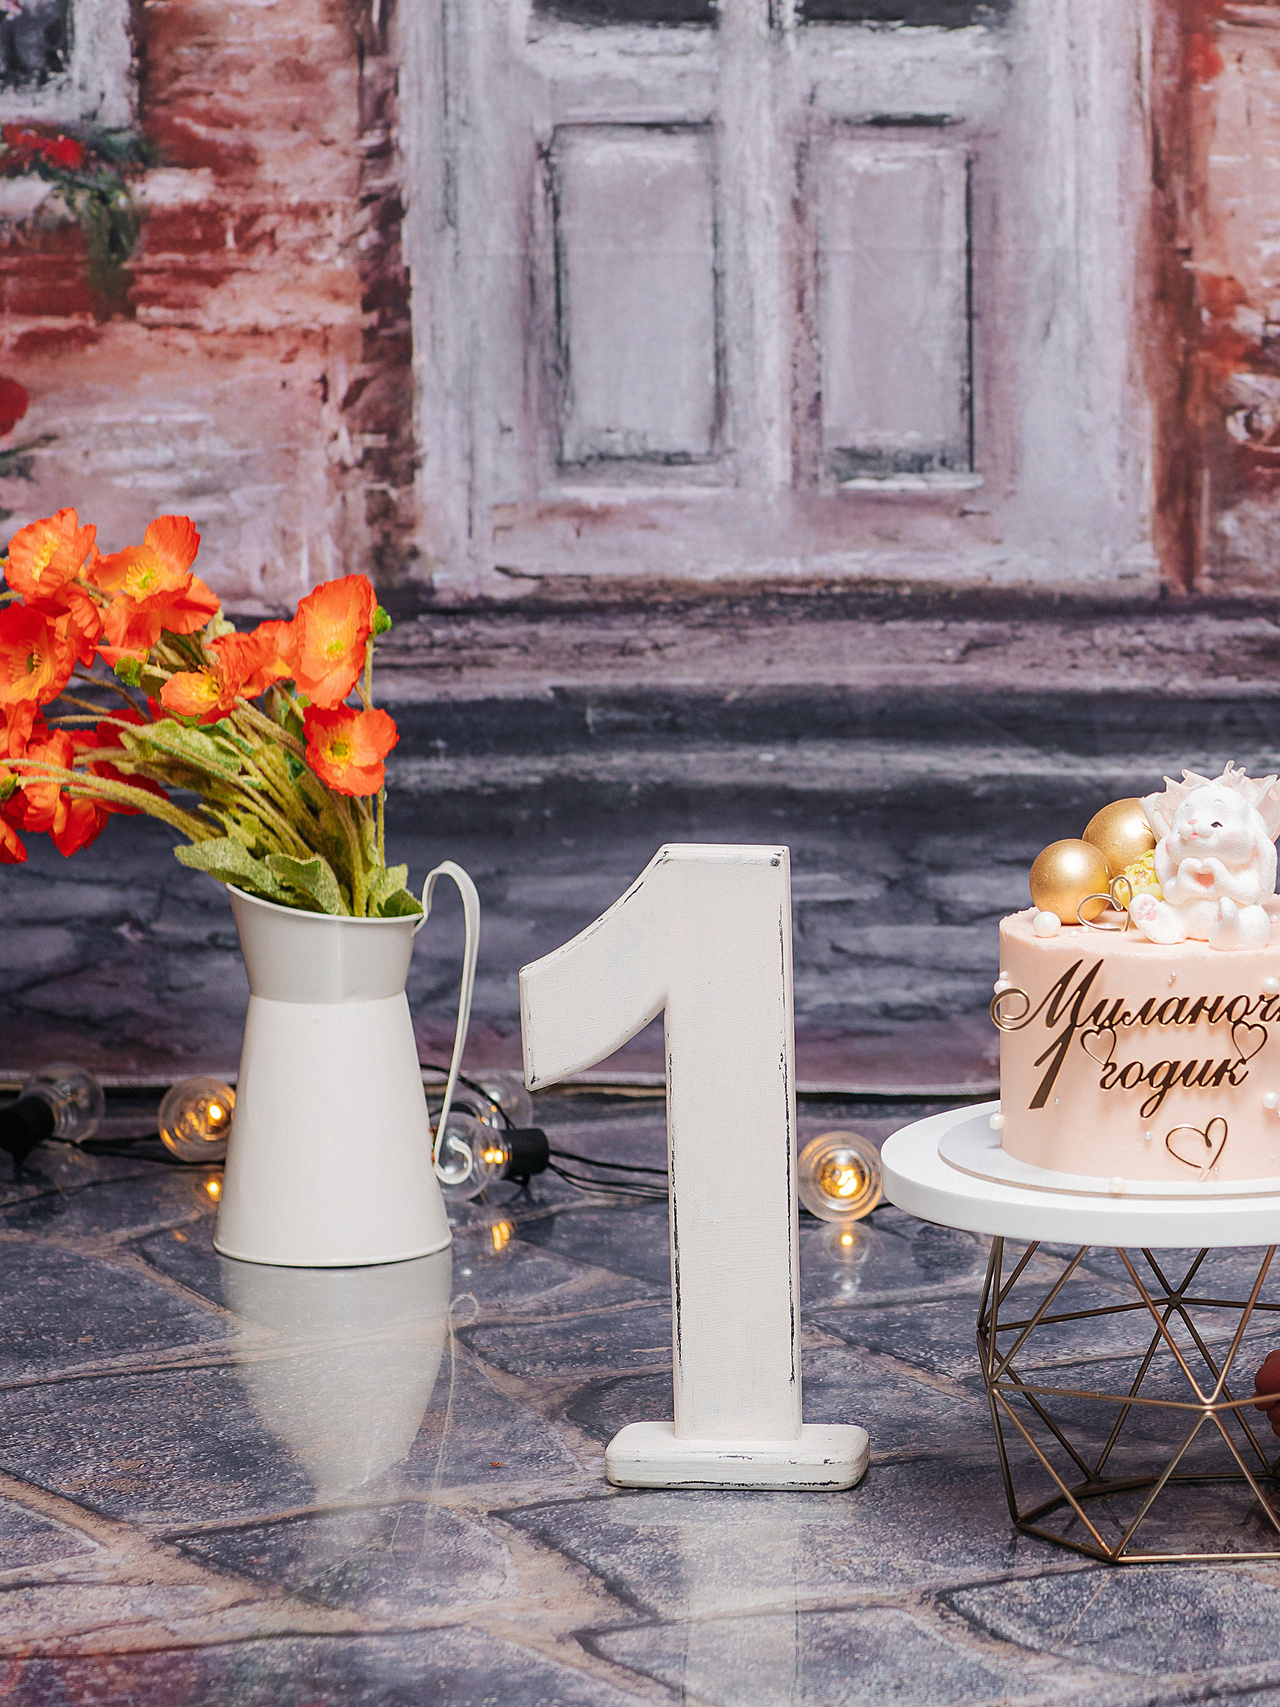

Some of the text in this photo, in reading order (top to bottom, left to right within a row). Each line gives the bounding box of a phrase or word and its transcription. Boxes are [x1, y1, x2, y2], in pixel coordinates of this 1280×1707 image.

[519, 843, 870, 1490] 1
[1028, 1025, 1249, 1118] 1 годик
